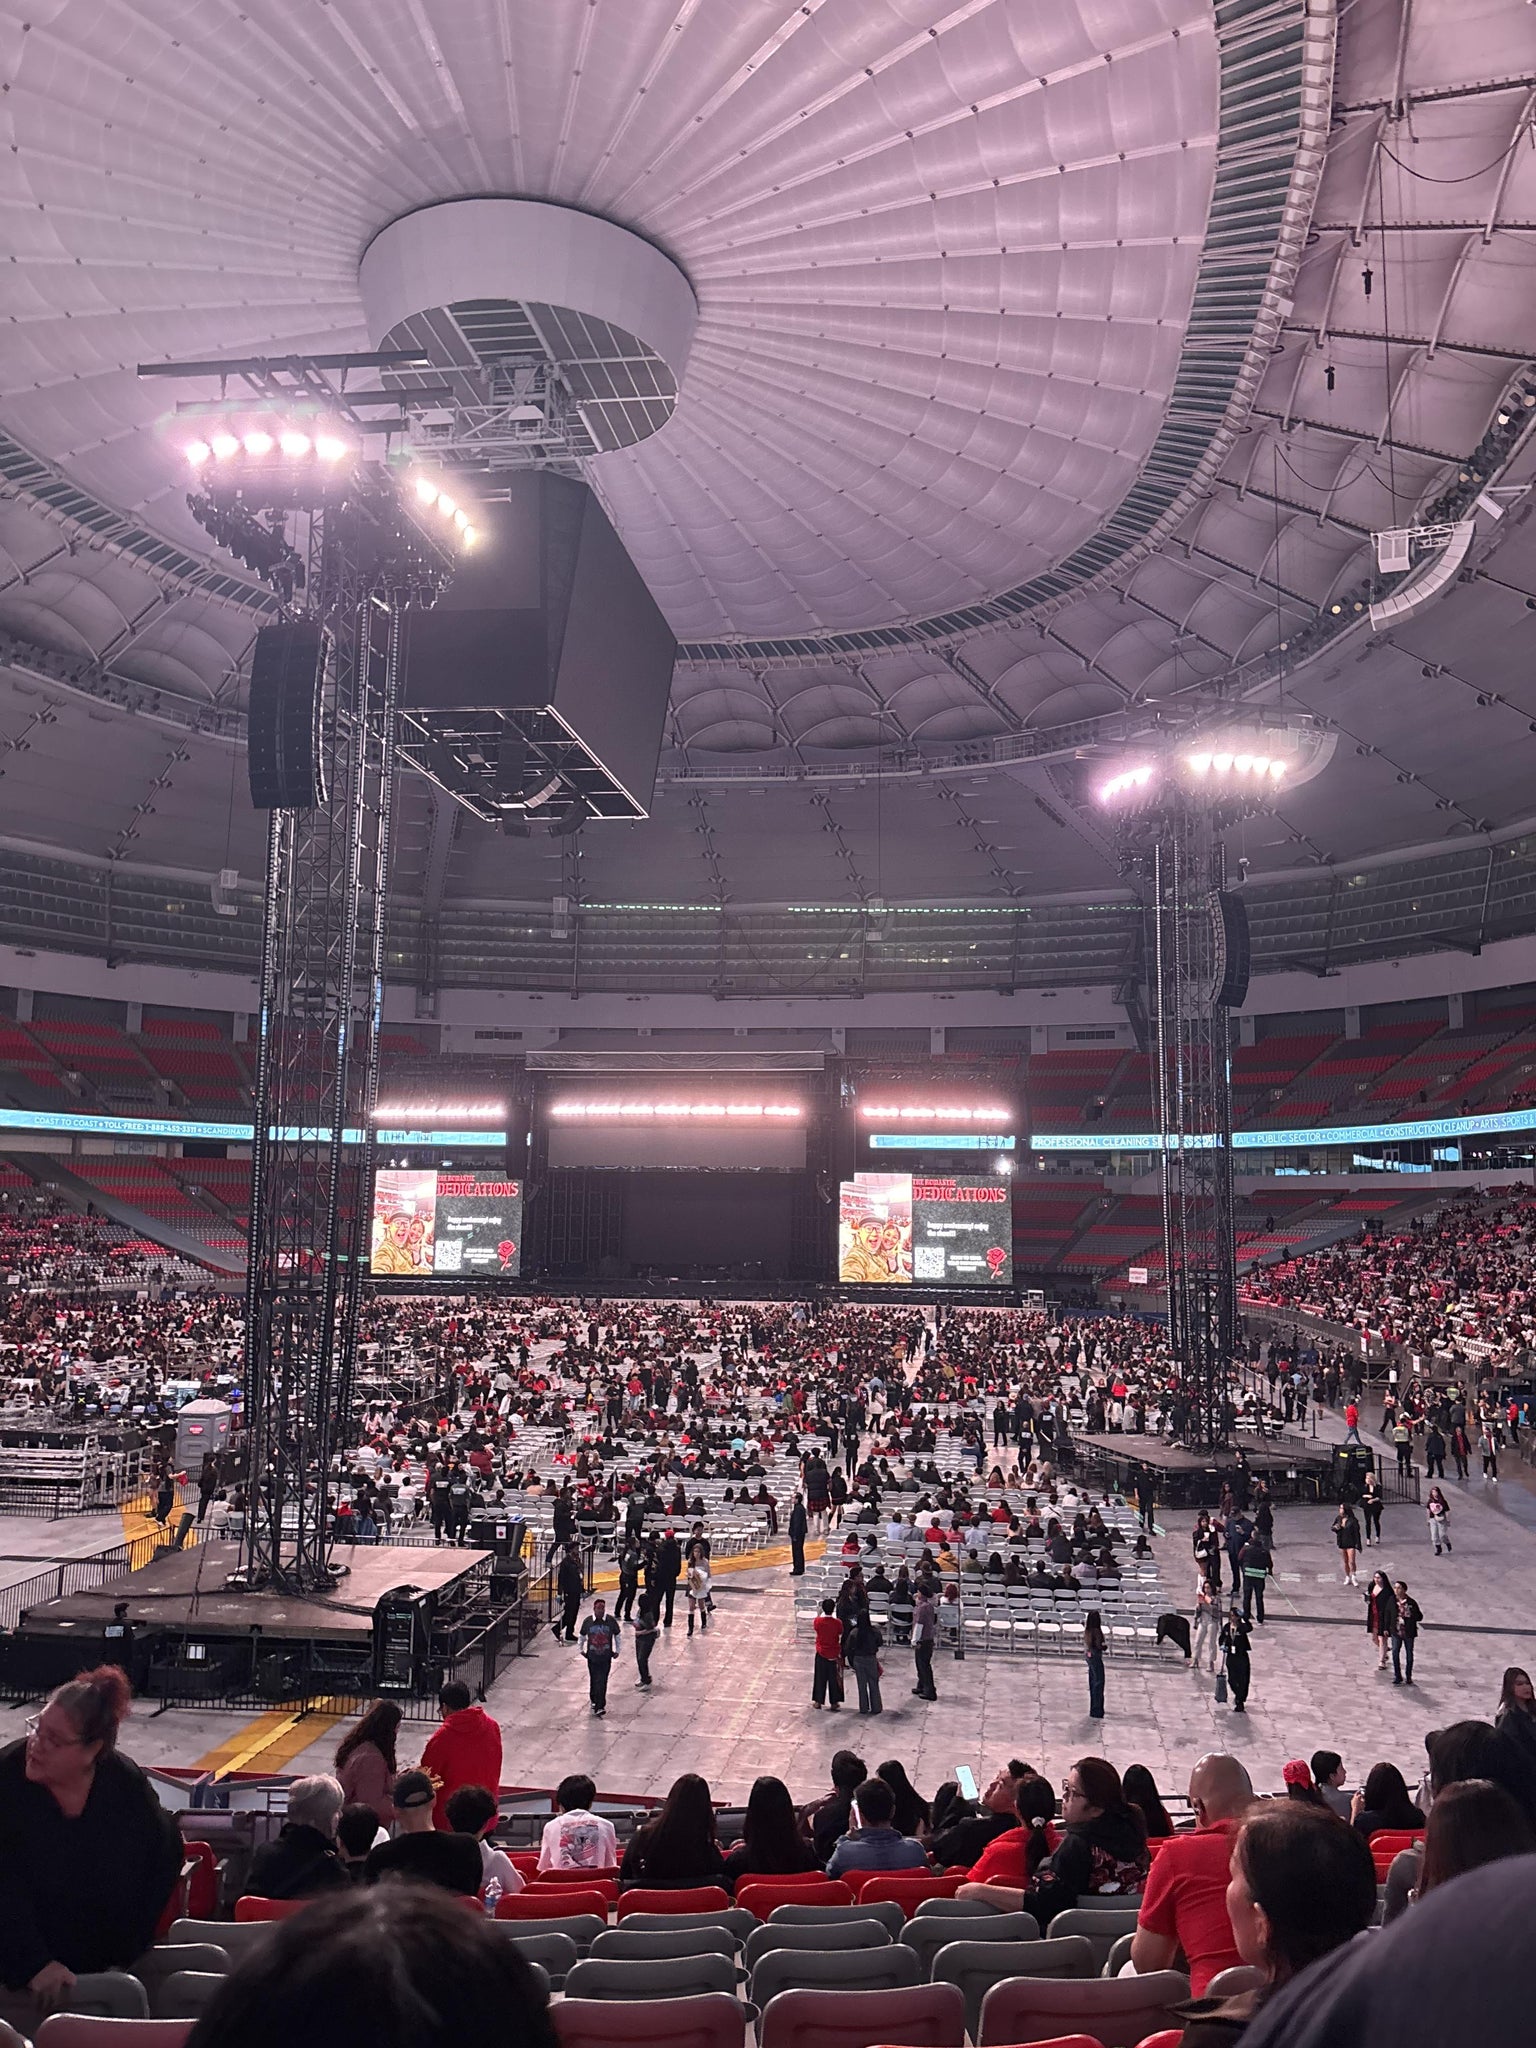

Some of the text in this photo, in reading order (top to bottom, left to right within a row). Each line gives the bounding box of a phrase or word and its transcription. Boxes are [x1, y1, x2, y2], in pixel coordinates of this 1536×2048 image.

[34, 1116, 59, 1125] COAST
[61, 1118, 71, 1126] TO
[73, 1119, 99, 1128] COAST
[1257, 1132, 1287, 1143] PUBLIC
[1289, 1131, 1321, 1142] SECTOR
[1327, 1129, 1379, 1141] COMMERCIAL
[1384, 1123, 1442, 1138] CONSTRUCTION
[1443, 1120, 1475, 1133] CLEANUP
[1480, 1117, 1501, 1129] ARTS,
[1502, 1114, 1528, 1126] SPORTS
[1033, 1137, 1100, 1147] PROFESSIONAL
[1103, 1137, 1150, 1147] CLEANING
[437, 1182, 519, 1197] DEDICATIONS
[912, 1186, 1007, 1203] DEDICATIONS
